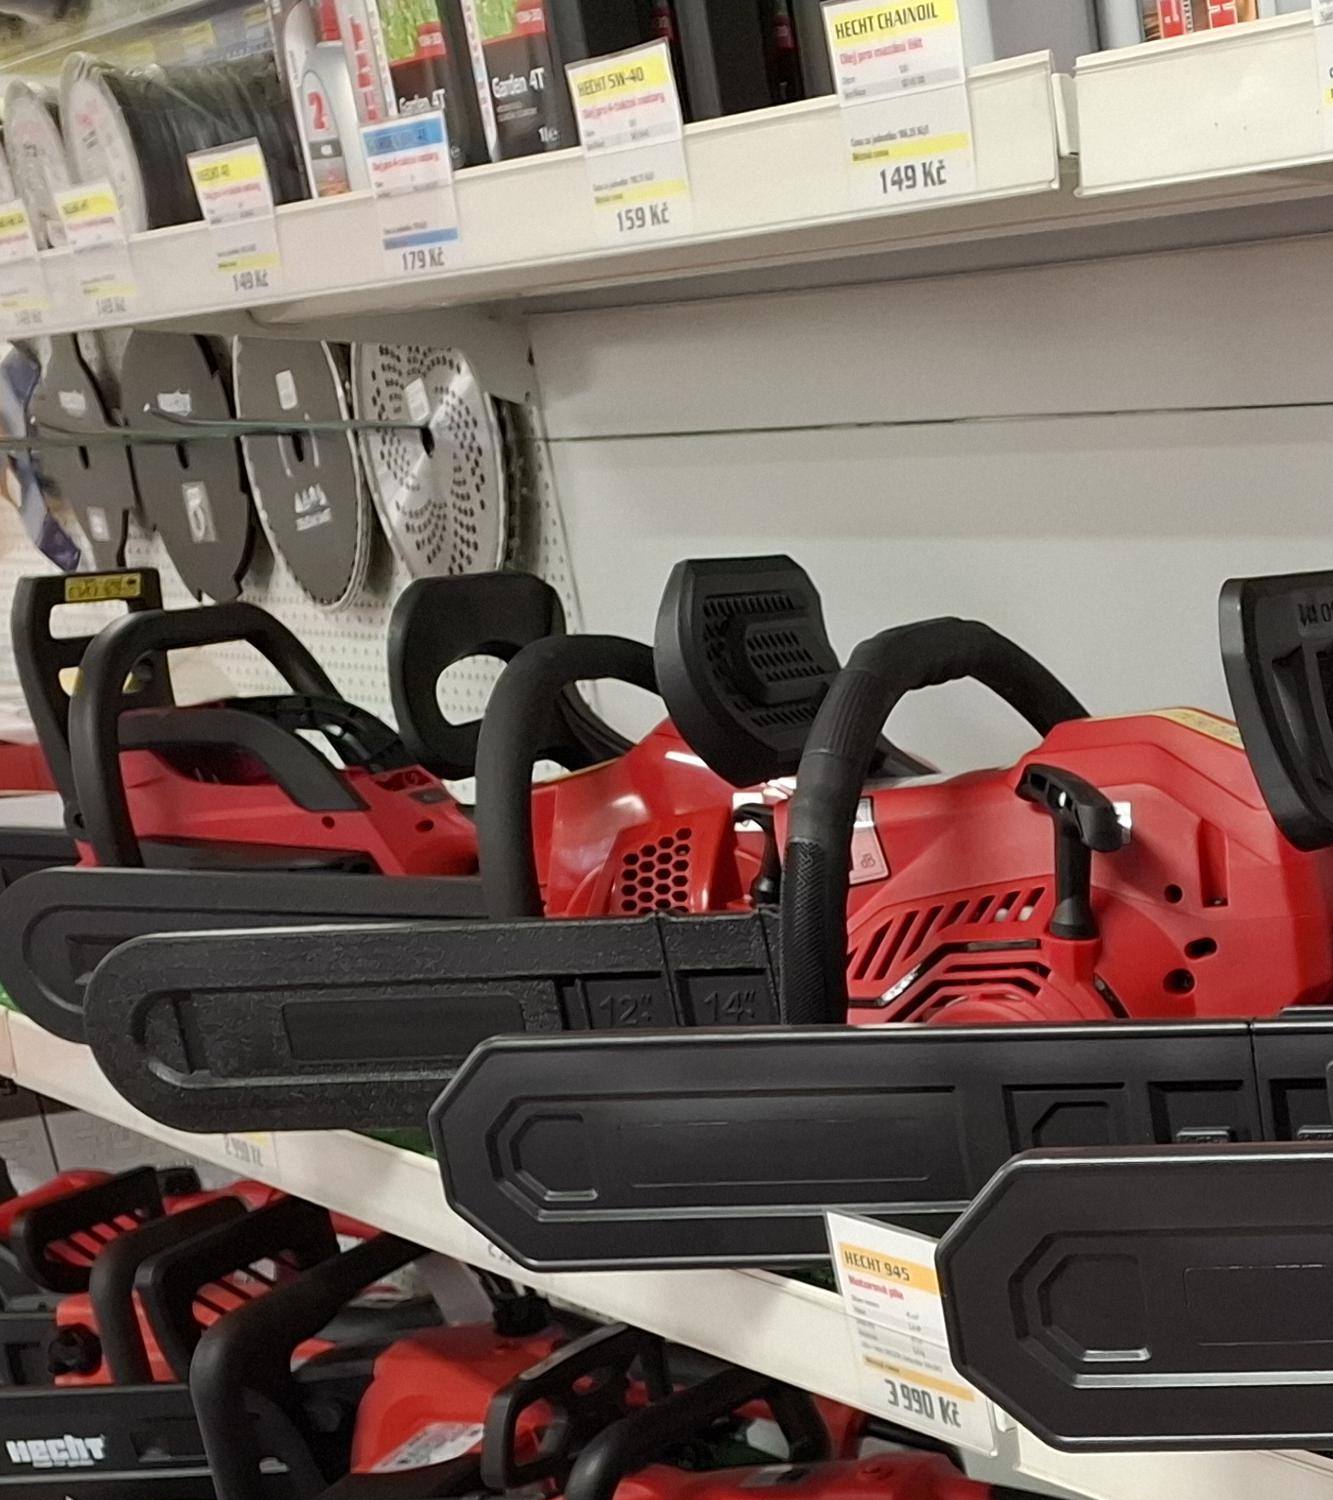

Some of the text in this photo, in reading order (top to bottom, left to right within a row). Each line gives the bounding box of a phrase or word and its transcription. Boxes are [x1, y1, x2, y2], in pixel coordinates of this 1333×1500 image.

[835, 2, 938, 40] HECHT CHAINOIL
[492, 67, 546, 99] Garden 4T
[578, 76, 607, 97] HECHT
[880, 159, 947, 194] 149 Kč
[616, 202, 670, 232] 159 Kč
[402, 246, 445, 272] 179 Kč
[845, 1250, 911, 1282] HECHT 945
[884, 1378, 962, 1429] 3 990 Kč
